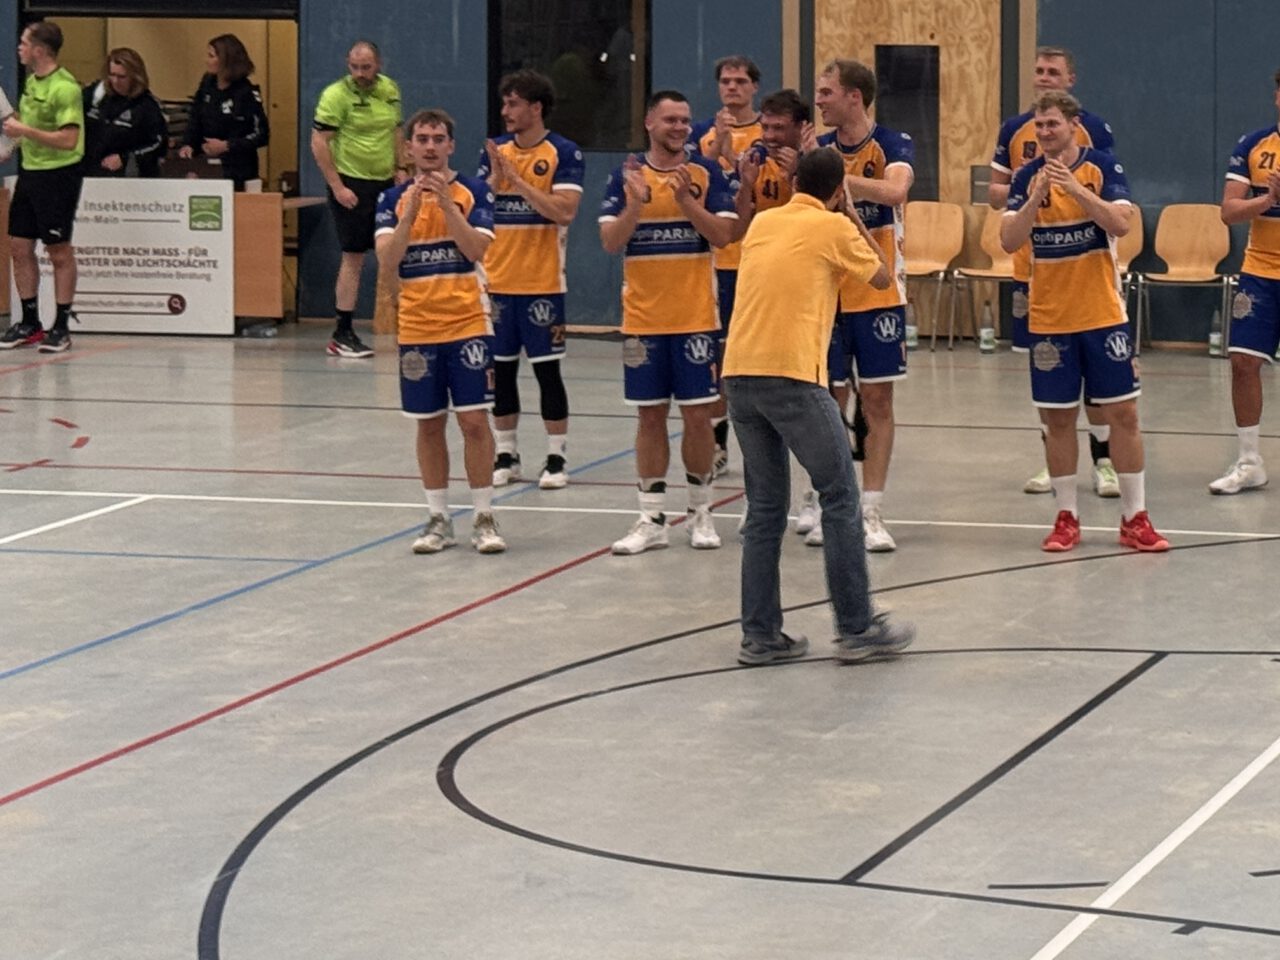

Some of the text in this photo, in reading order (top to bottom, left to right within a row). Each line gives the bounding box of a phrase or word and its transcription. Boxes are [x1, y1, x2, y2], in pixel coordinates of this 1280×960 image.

[1258, 151, 1276, 170] 21
[83, 200, 185, 213] Insektenschutz
[122, 247, 150, 258] NACH
[151, 247, 180, 258] MASS
[187, 246, 209, 257] FÜR
[112, 257, 135, 268] UND
[136, 258, 218, 269] LICHTSCHÄCHTE
